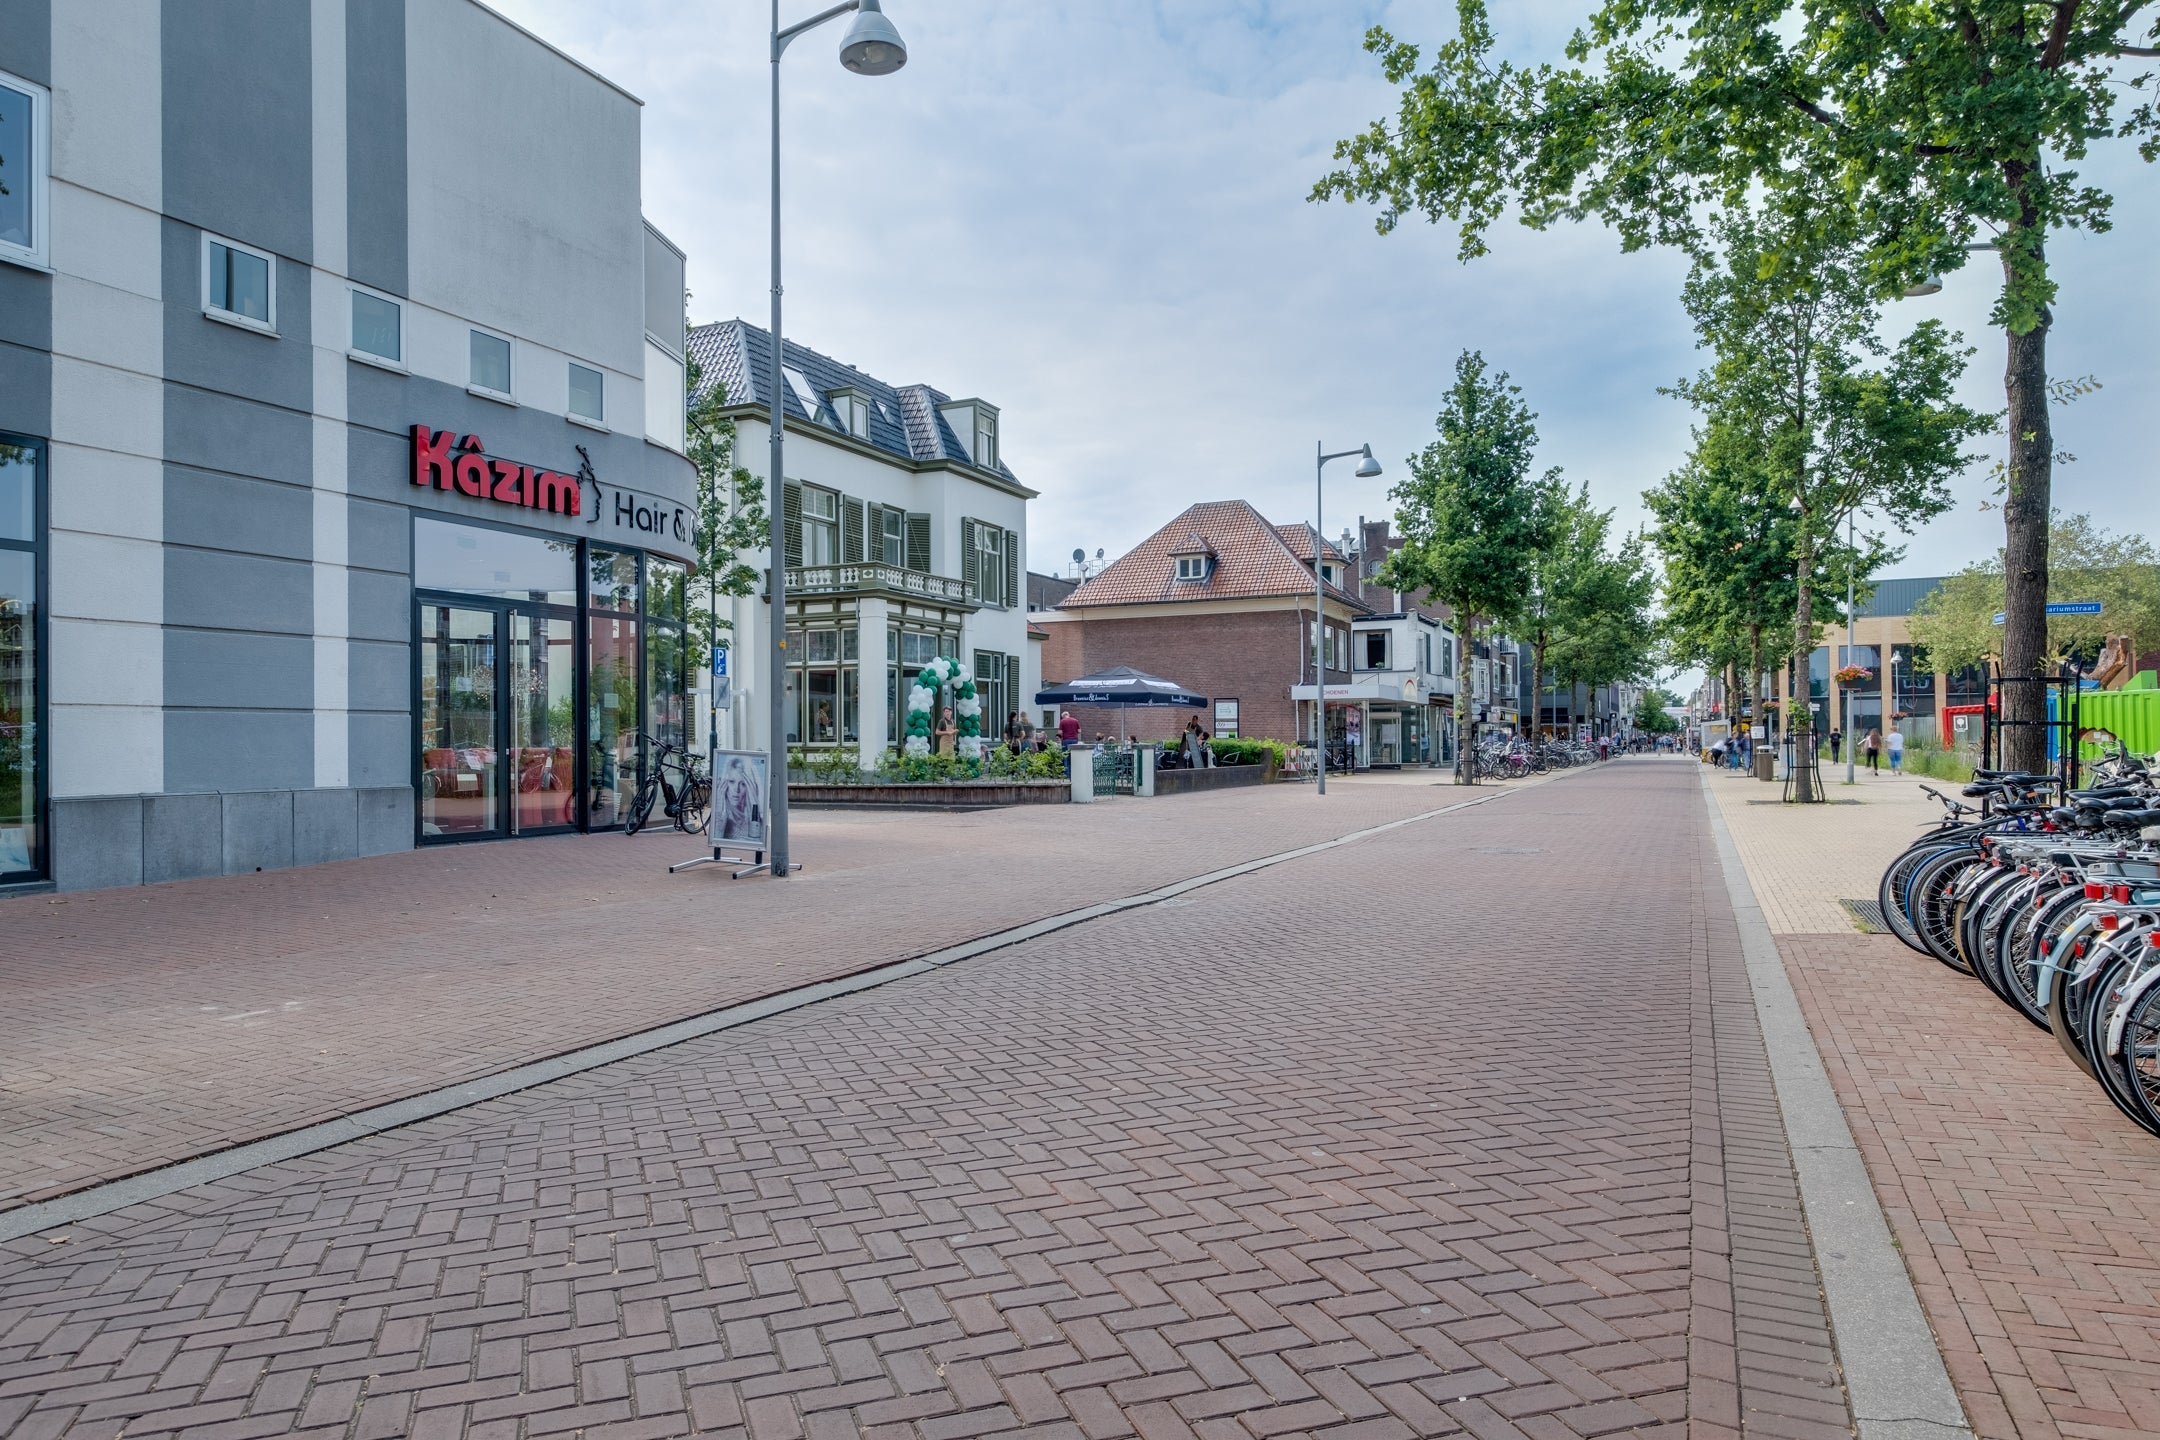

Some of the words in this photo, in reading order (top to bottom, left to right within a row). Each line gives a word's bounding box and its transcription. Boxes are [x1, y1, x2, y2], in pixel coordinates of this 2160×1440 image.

[615, 491, 667, 534] Hair
[673, 508, 686, 542] &
[717, 649, 725, 664] P
